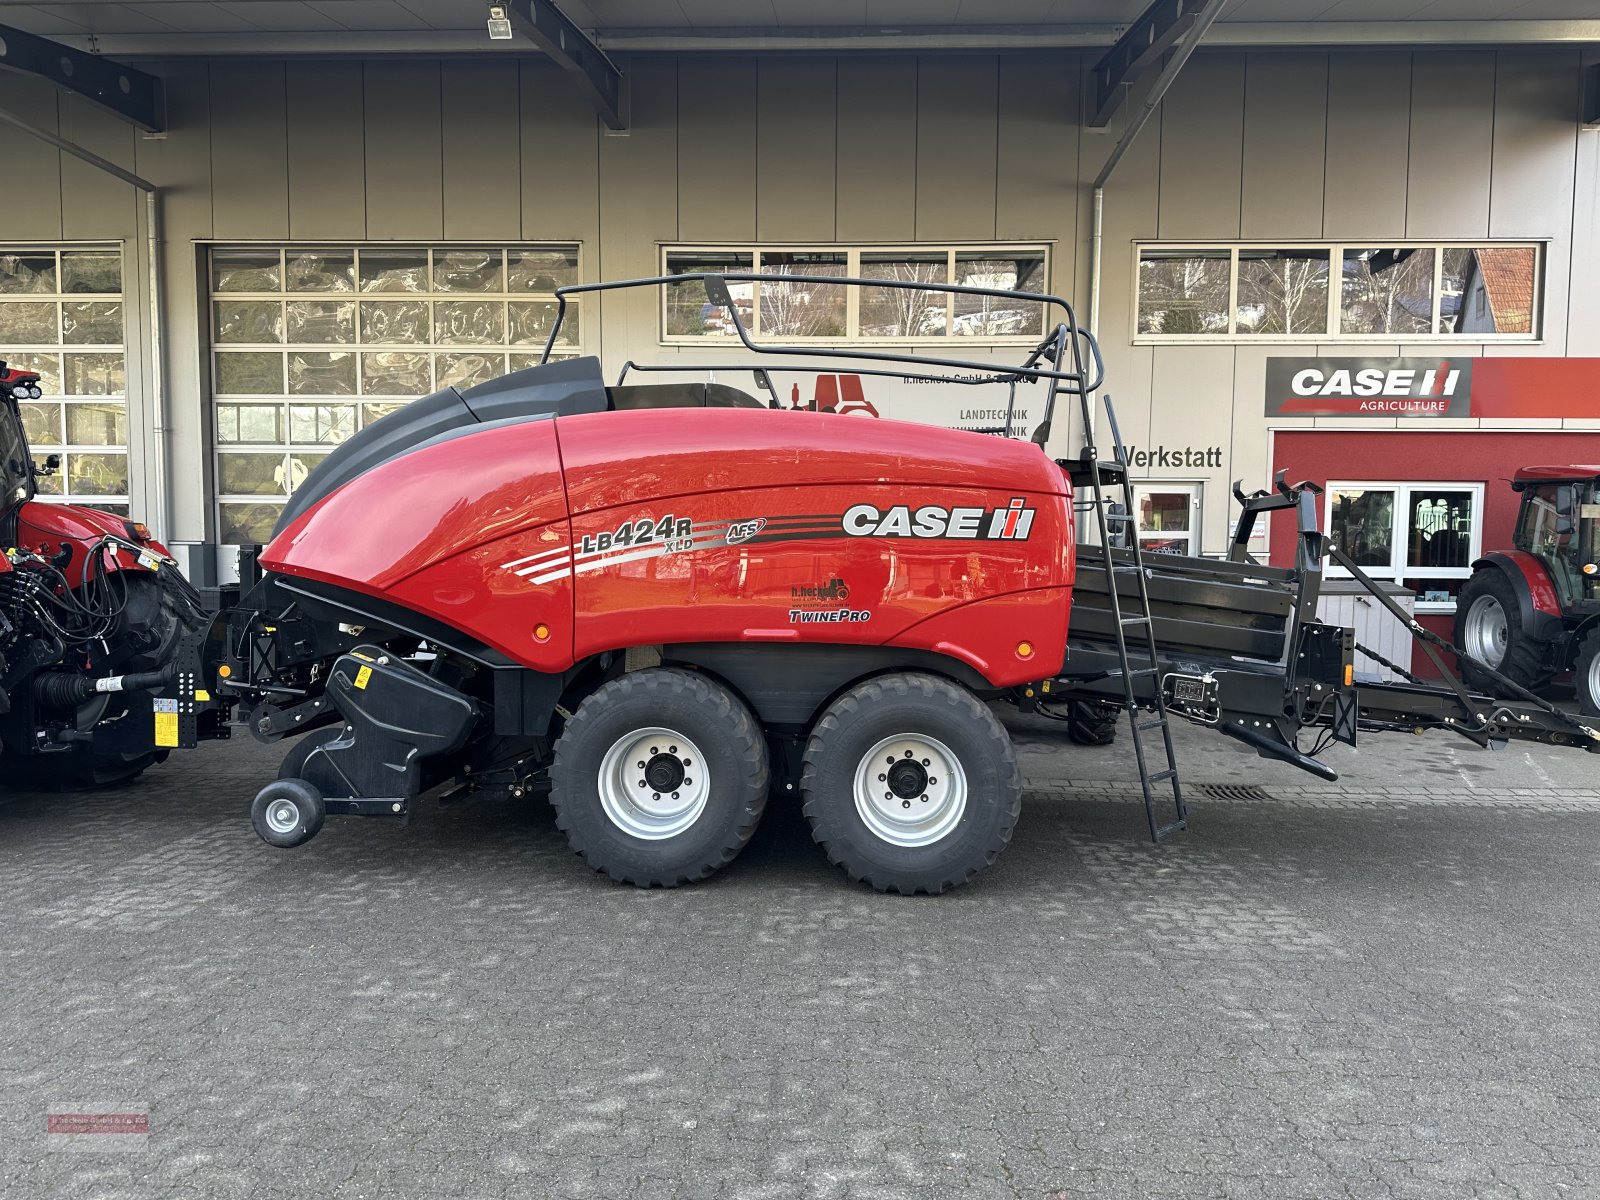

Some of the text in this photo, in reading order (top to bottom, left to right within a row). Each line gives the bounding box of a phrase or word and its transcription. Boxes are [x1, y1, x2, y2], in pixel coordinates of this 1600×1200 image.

[1291, 368, 1416, 396] CASE
[960, 409, 1028, 420] LANDTECHNIK
[1359, 401, 1445, 411] AGRICULTURE
[1112, 445, 1222, 468] Werkstatt
[726, 522, 759, 541] AFS
[842, 504, 984, 538] CASE
[581, 514, 693, 554] LB424R
[663, 539, 693, 554] XLD
